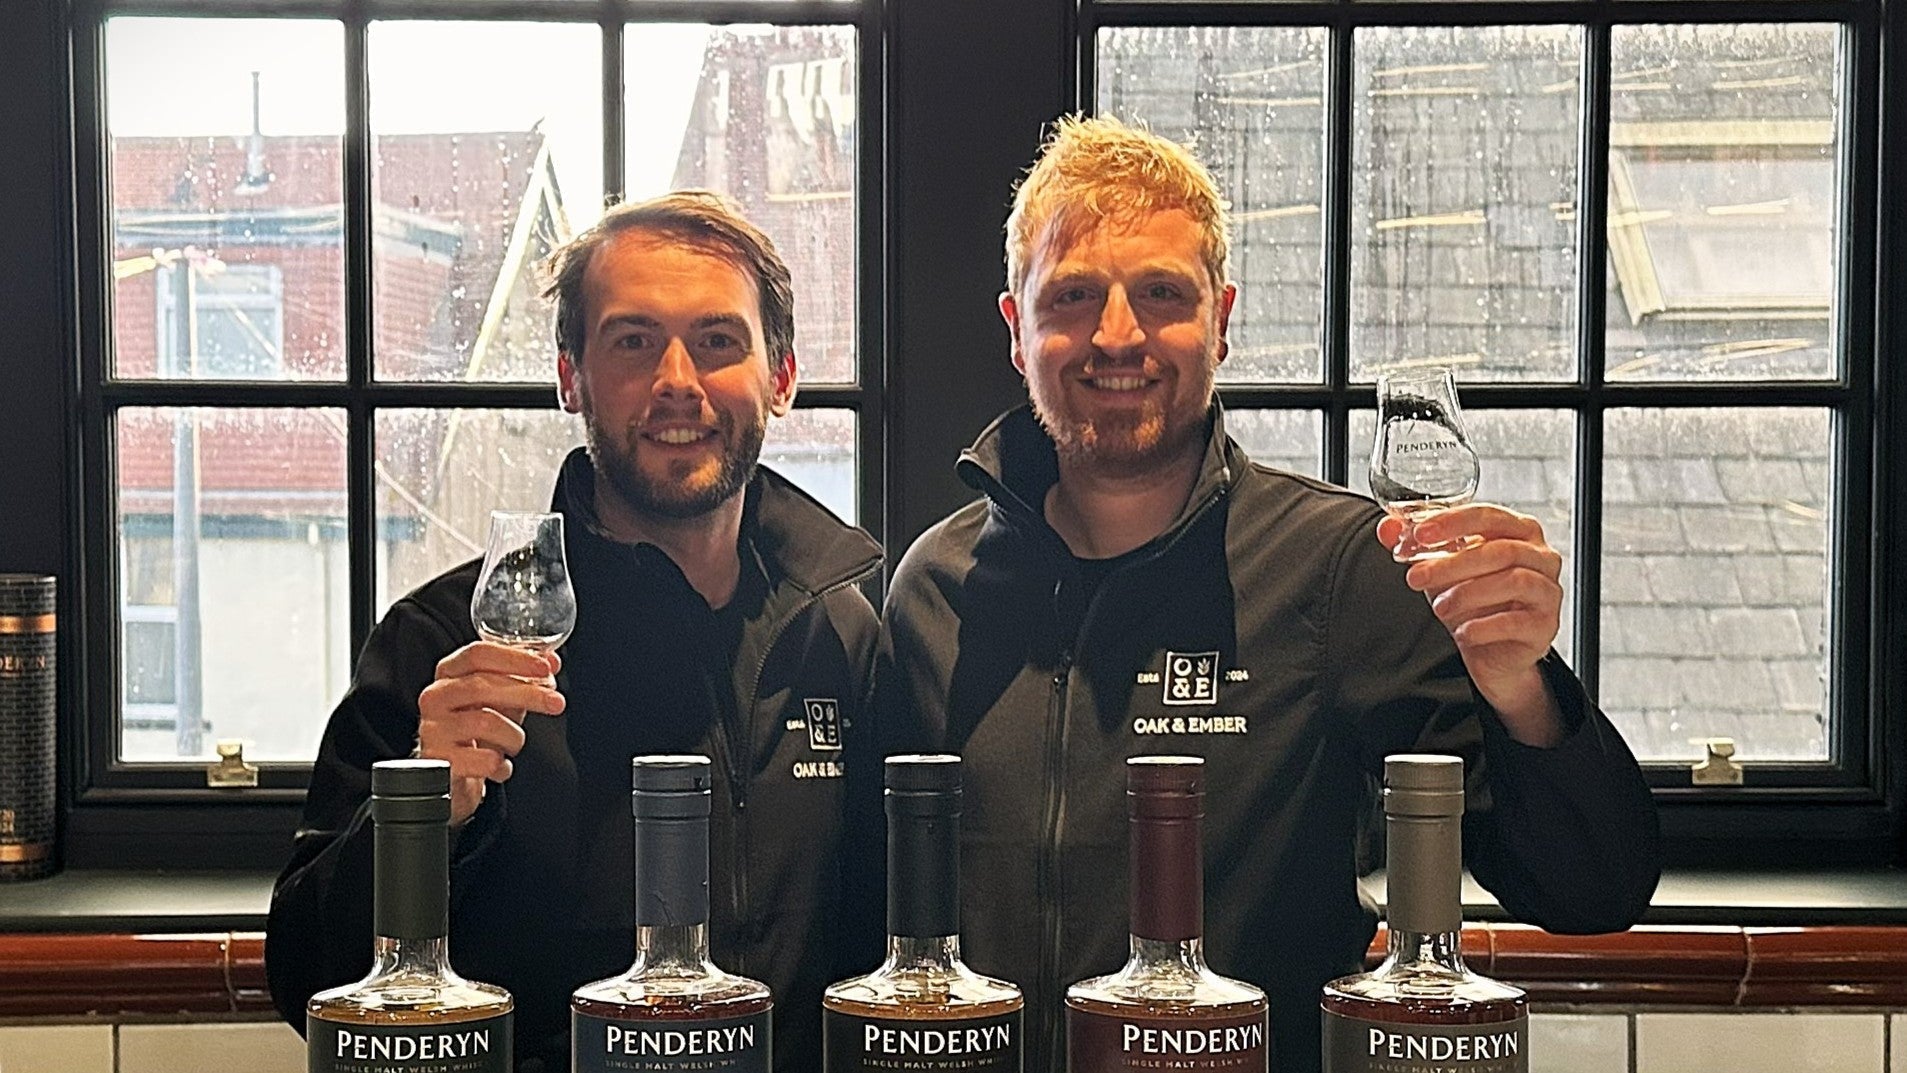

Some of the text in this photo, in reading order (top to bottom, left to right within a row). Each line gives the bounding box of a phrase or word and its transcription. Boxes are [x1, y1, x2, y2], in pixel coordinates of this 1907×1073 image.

[1396, 441, 1458, 453] PENDERYN
[1133, 716, 1248, 734] OAK & EMBER
[793, 762, 818, 778] OAK
[337, 1029, 489, 1061] PENDERYN
[606, 1025, 754, 1056] PENDERYN
[864, 1023, 1010, 1055] PENDERYN
[1123, 1022, 1262, 1054] PENDERYN
[1368, 1028, 1518, 1061] PENDERYN
[645, 1062, 674, 1070] MALT
[903, 1061, 934, 1070] MALT
[1165, 1061, 1196, 1069] MALT
